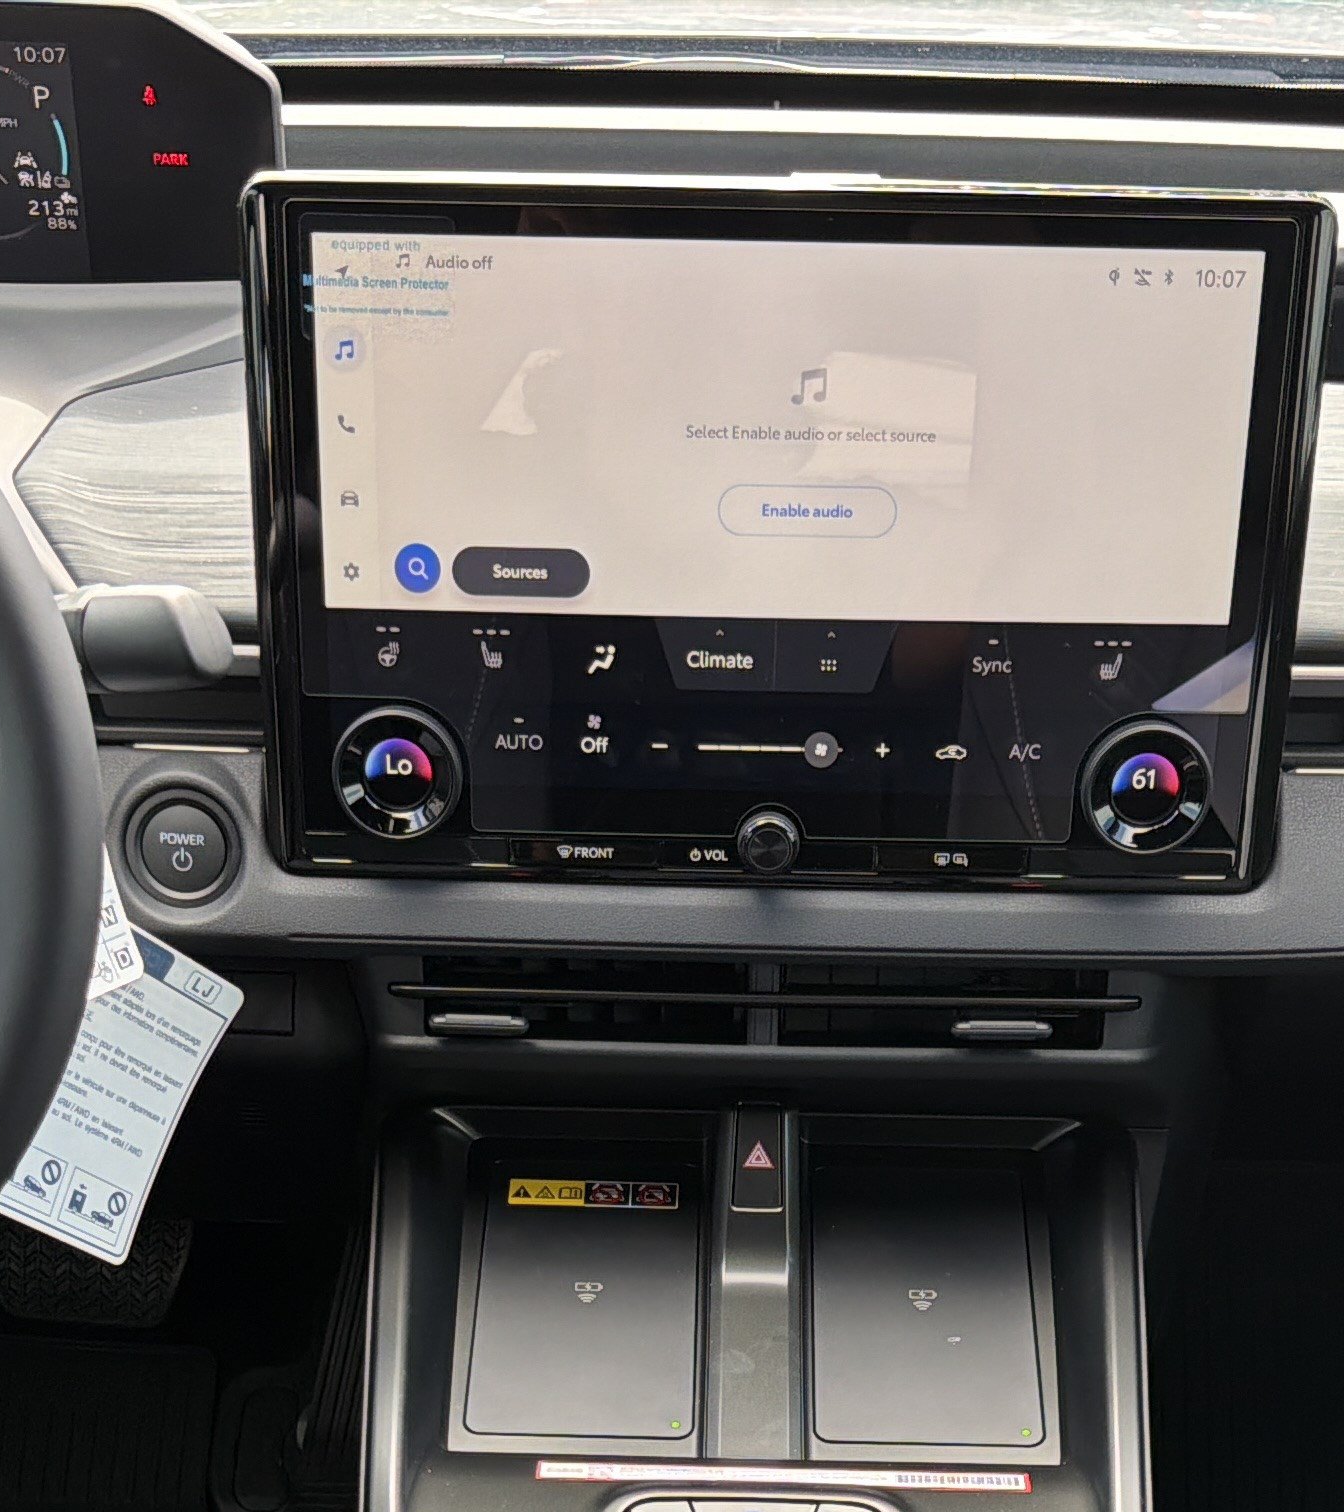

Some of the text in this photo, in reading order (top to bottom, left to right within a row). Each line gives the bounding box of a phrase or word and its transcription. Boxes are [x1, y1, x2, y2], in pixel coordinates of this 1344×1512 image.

[13, 46, 67, 64] 10:07
[33, 85, 50, 109] P
[153, 152, 190, 166] PARK
[47, 217, 78, 230] 88%
[331, 240, 421, 252] equipped with
[425, 255, 493, 270] Audio off
[361, 276, 398, 289] Screen
[400, 276, 450, 291] Protector
[1196, 269, 1247, 288] 10:07
[686, 425, 937, 443] Select Enable audio or select source
[761, 503, 853, 519] Enable audio
[492, 563, 549, 581] Sources
[686, 650, 754, 669] Climate
[972, 656, 1013, 676] Sync
[494, 734, 544, 751] AUTO
[580, 737, 609, 754] Off
[1008, 743, 1042, 763] A/C
[385, 754, 413, 776] Lo
[1131, 768, 1156, 789] 61
[159, 832, 205, 846] POWER
[574, 847, 614, 859] FRONT
[703, 849, 729, 862] VOL
[191, 976, 216, 998] LJ
